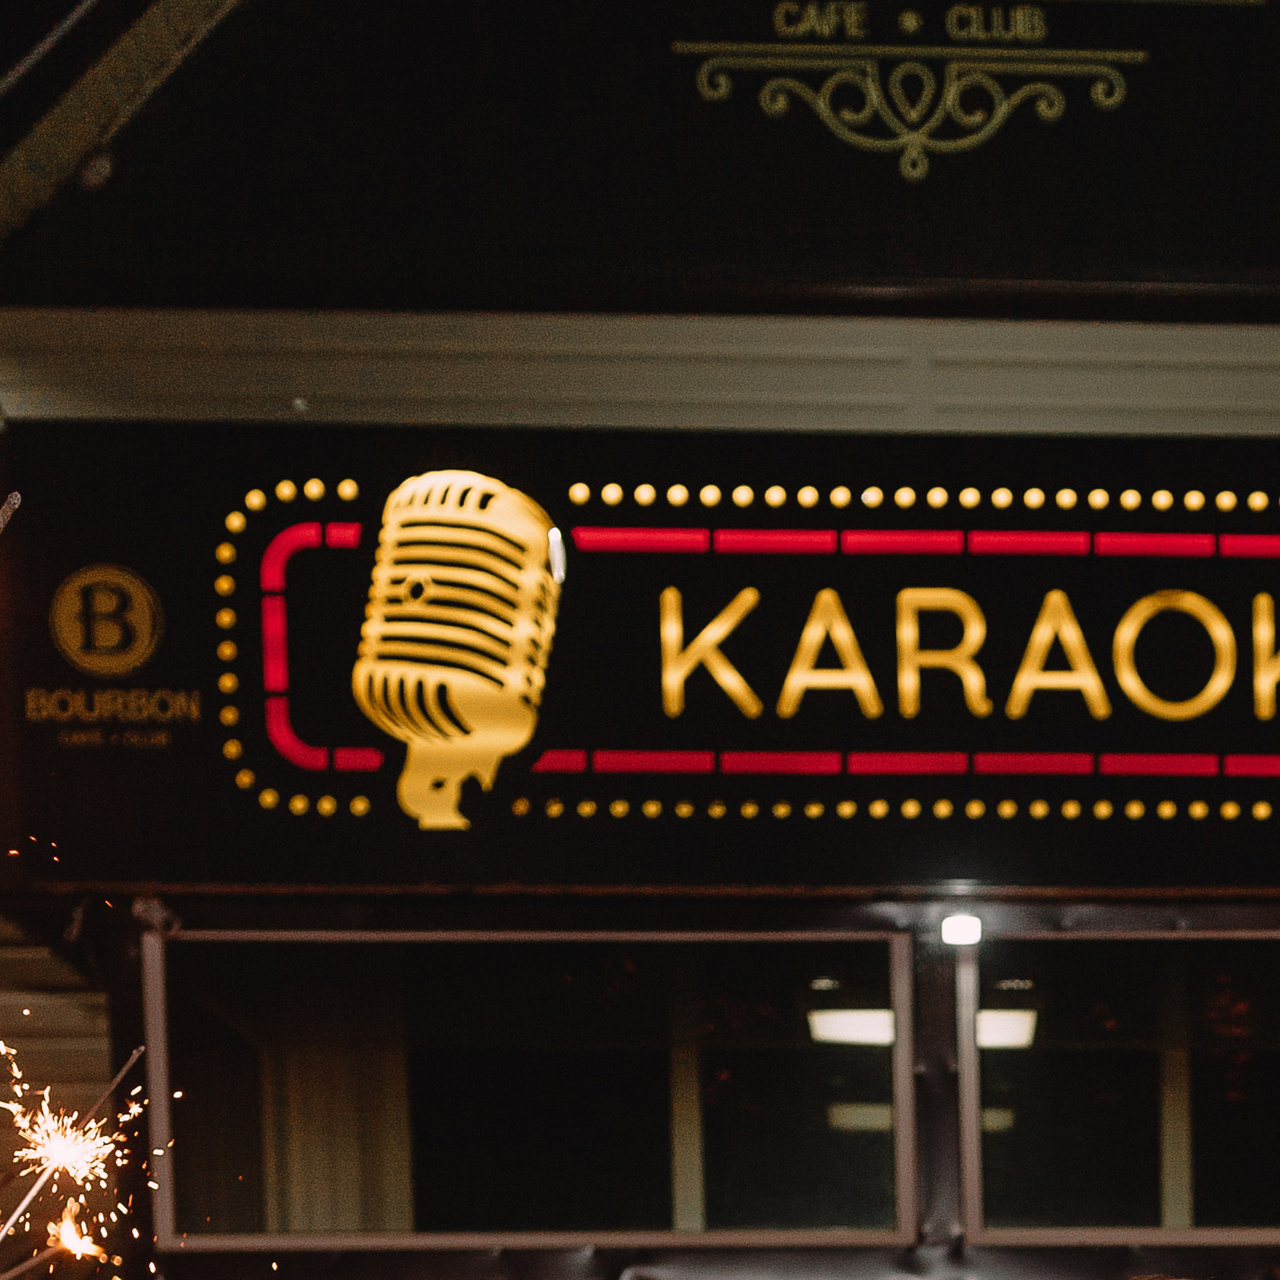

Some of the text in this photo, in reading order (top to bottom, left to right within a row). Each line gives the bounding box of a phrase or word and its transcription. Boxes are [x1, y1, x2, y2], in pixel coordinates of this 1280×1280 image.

[772, 0, 1049, 43] CAFE CLUB
[25, 686, 202, 724] BOURBON
